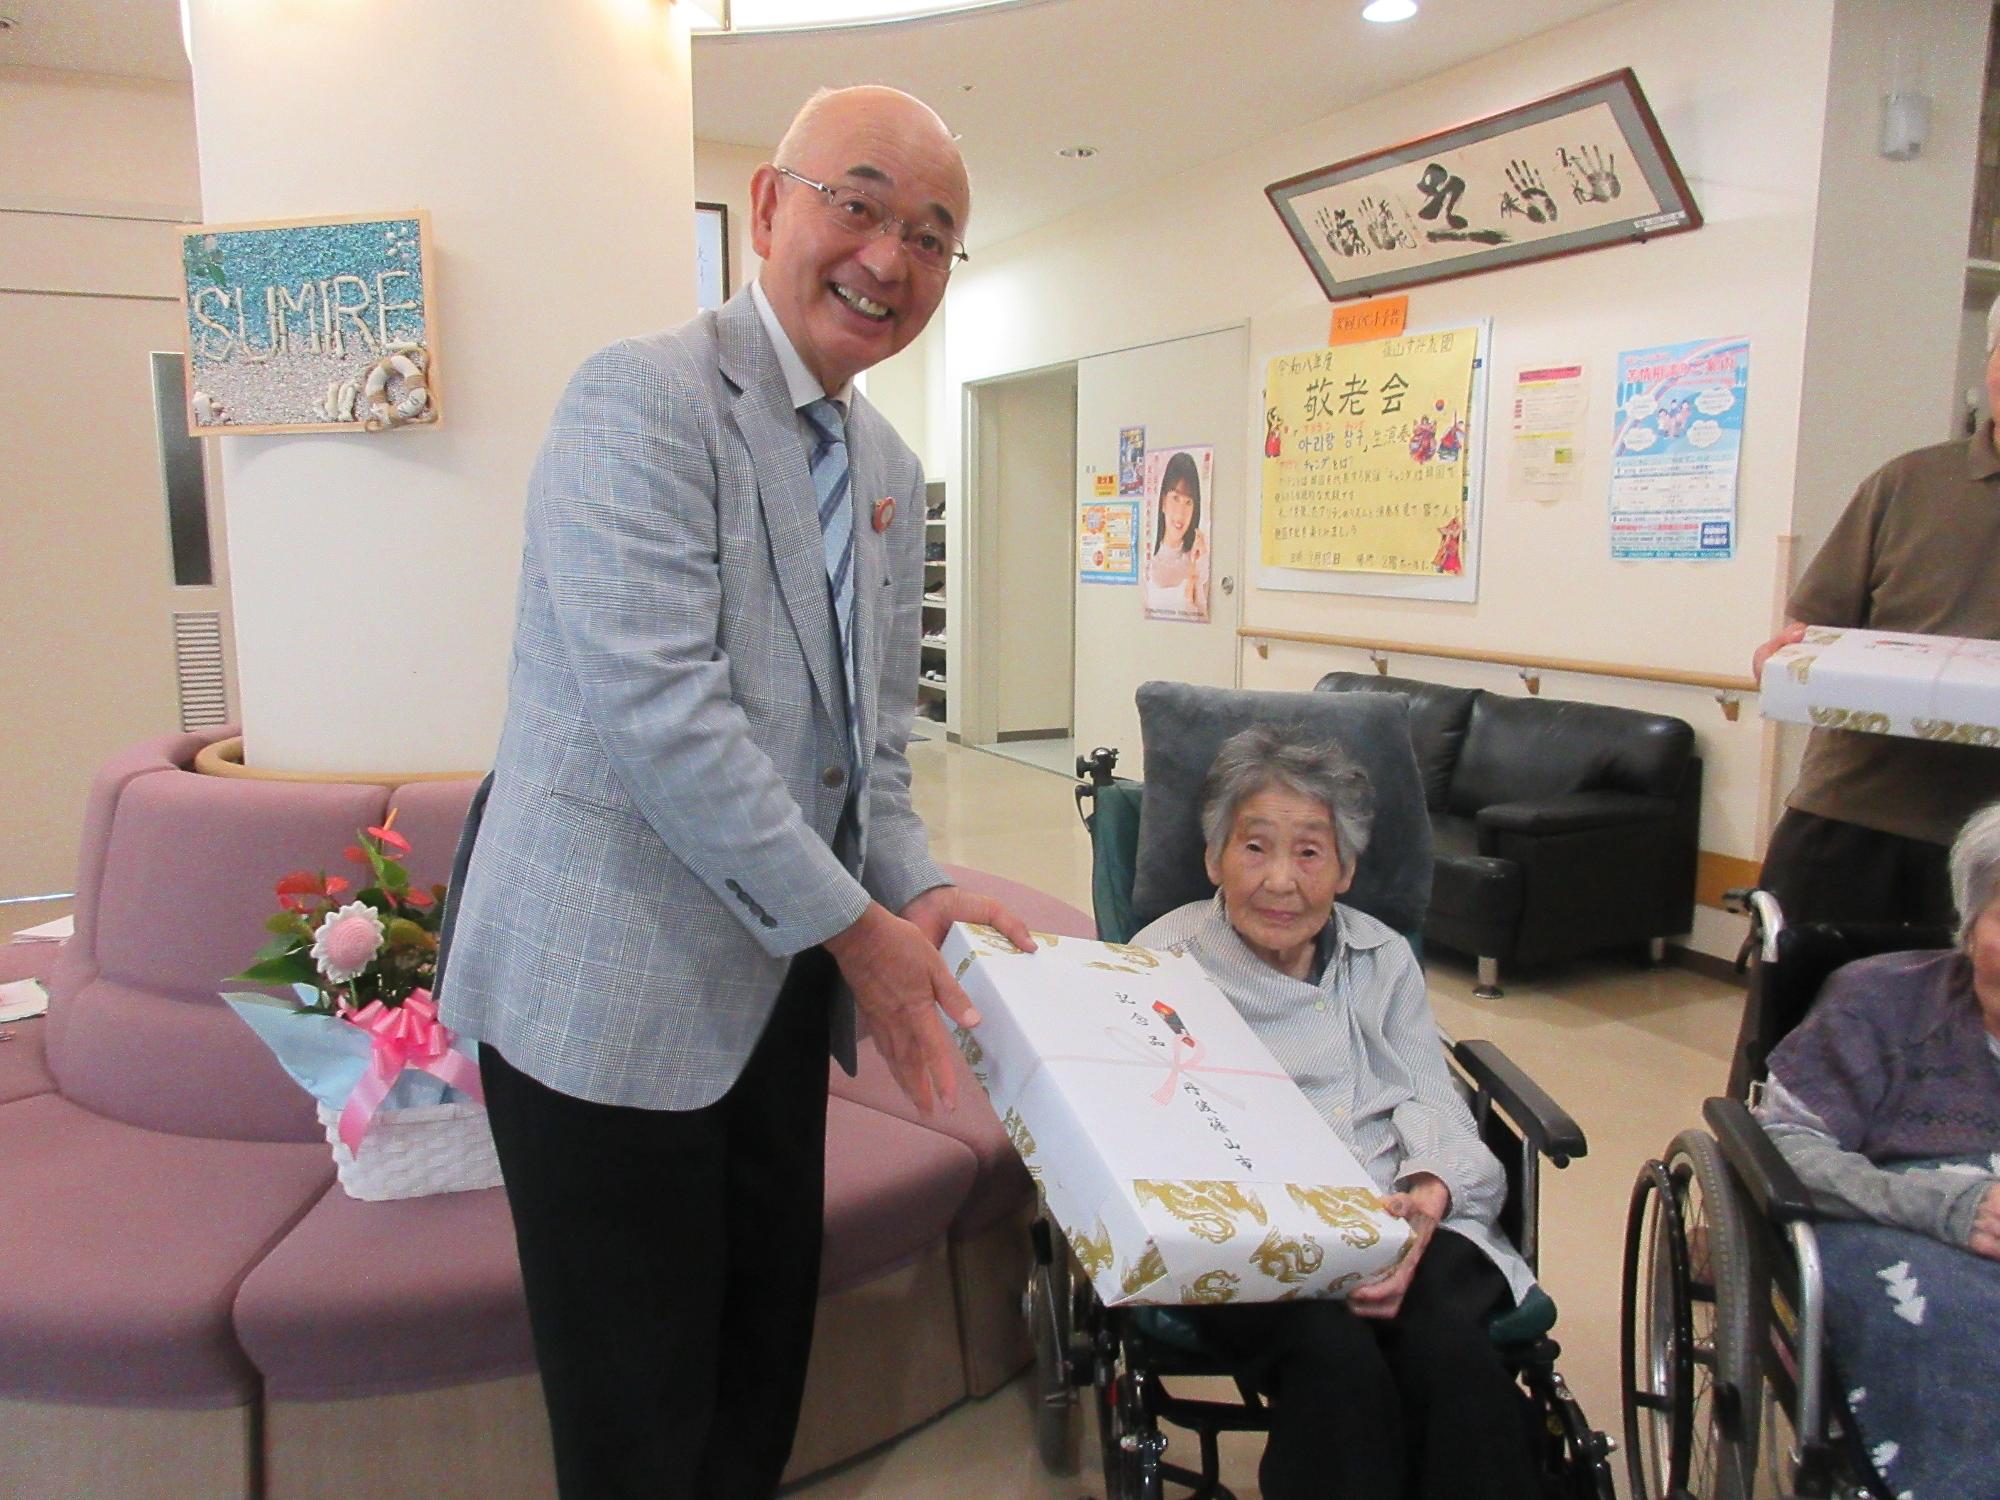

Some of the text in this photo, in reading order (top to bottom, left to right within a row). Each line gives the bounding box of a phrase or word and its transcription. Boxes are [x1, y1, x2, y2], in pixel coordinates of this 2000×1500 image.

[194, 271, 423, 362] SUMIRE
[1304, 372, 1409, 421] 敬老会
